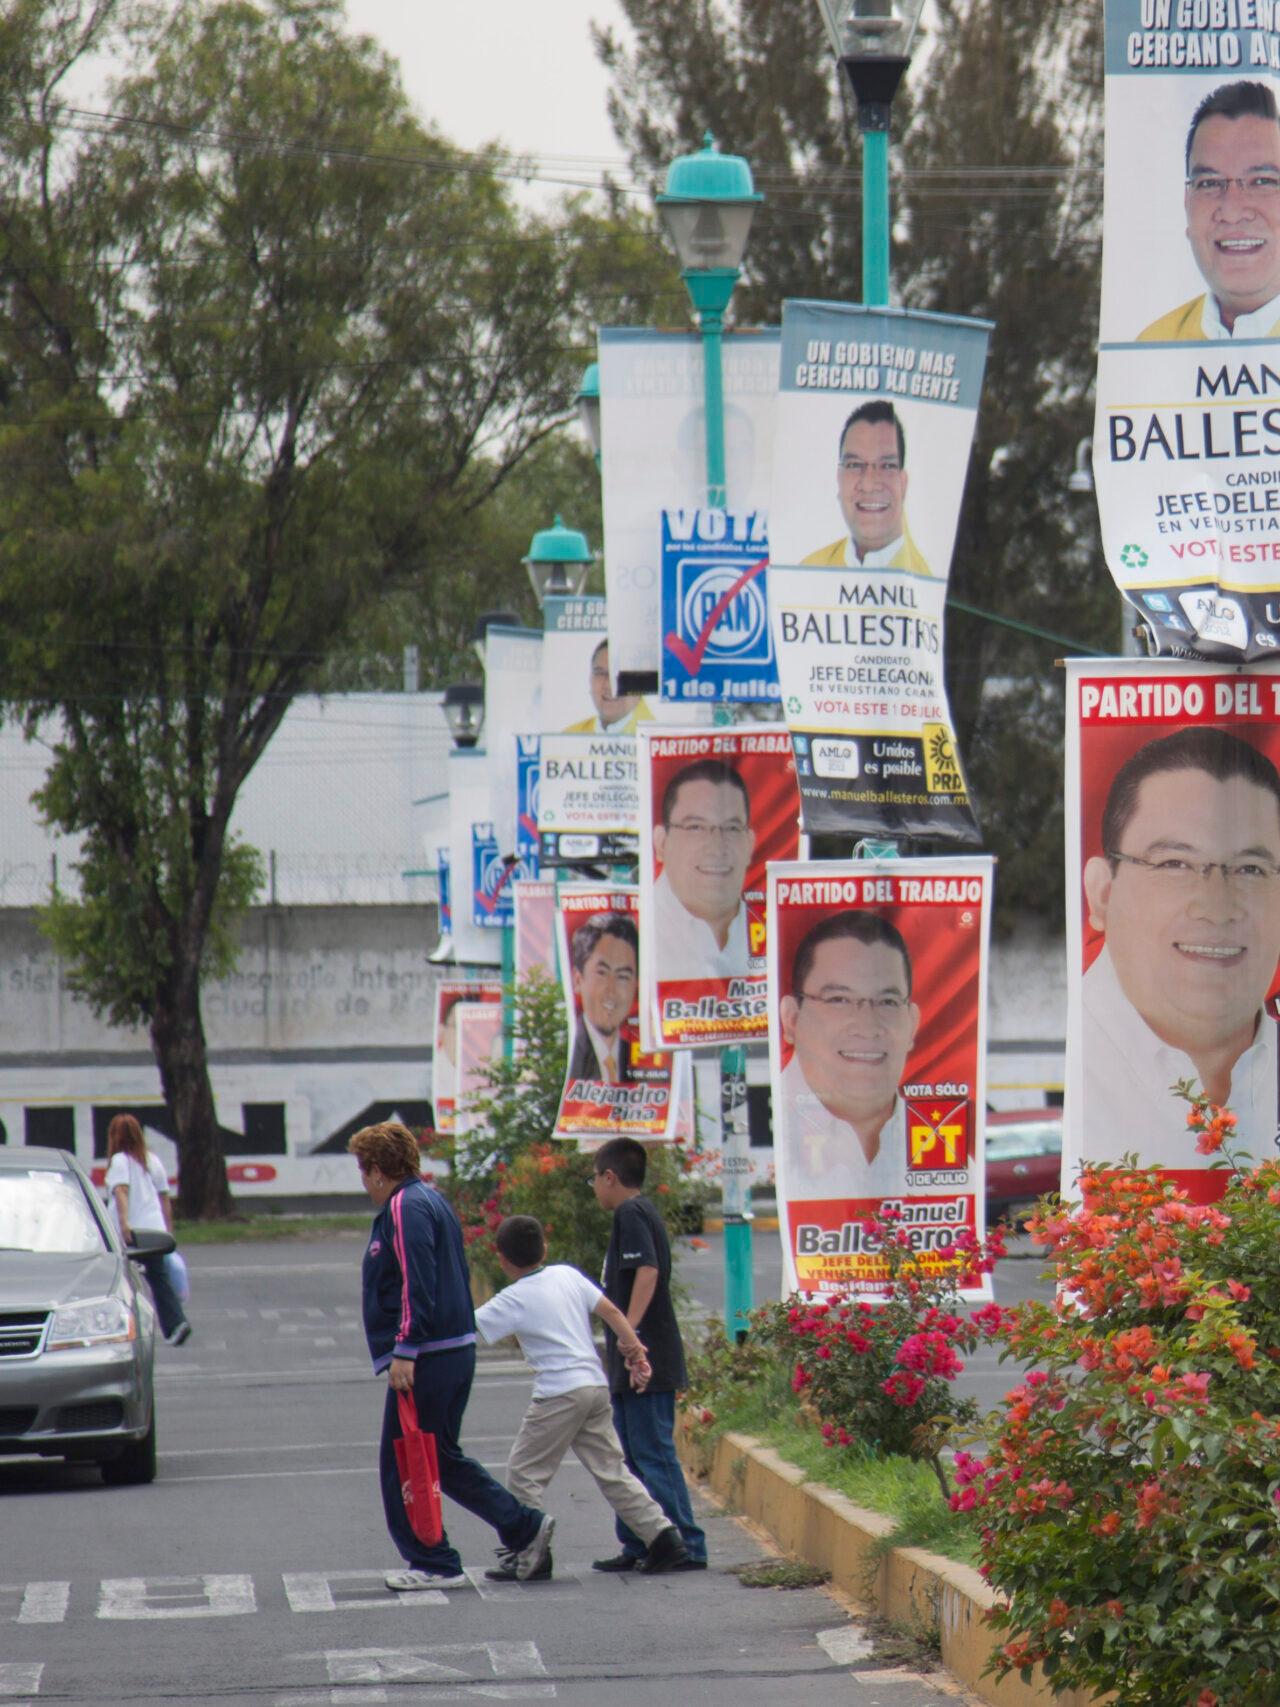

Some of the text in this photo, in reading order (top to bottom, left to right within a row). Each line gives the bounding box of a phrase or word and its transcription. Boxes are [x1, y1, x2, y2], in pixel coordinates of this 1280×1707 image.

[1127, 32, 1241, 67] CERCANO
[807, 342, 831, 364] UN
[919, 350, 955, 378] MAS
[796, 364, 880, 390] CERCANO
[910, 375, 960, 402] GENTE
[1154, 492, 1216, 517] JEFE
[1158, 521, 1182, 534] EN
[701, 592, 749, 632] PAN
[1256, 633, 1276, 647] es
[855, 655, 910, 666] CANDIDATO
[810, 667, 844, 681] JEFE
[664, 679, 780, 697] 1 de Julio
[810, 685, 824, 693] EN
[815, 700, 849, 714] VOTA
[855, 701, 888, 715] ESTE
[901, 705, 919, 717] DE
[1081, 684, 1203, 718] PARTIDO
[1214, 683, 1262, 716] DEL
[651, 737, 707, 757] PARTIDO
[873, 742, 915, 758] Unidos
[865, 762, 922, 778] es posible
[777, 880, 981, 904] PARTIDO DEL TRABAJO
[666, 998, 766, 1019] Balleste
[570, 1083, 668, 1107] Alejandro
[904, 1083, 968, 1096] VOTA SÓLO
[911, 1125, 962, 1164] PT
[907, 1173, 968, 1186] 1 DE JULIO
[822, 1256, 852, 1267] JEFE
